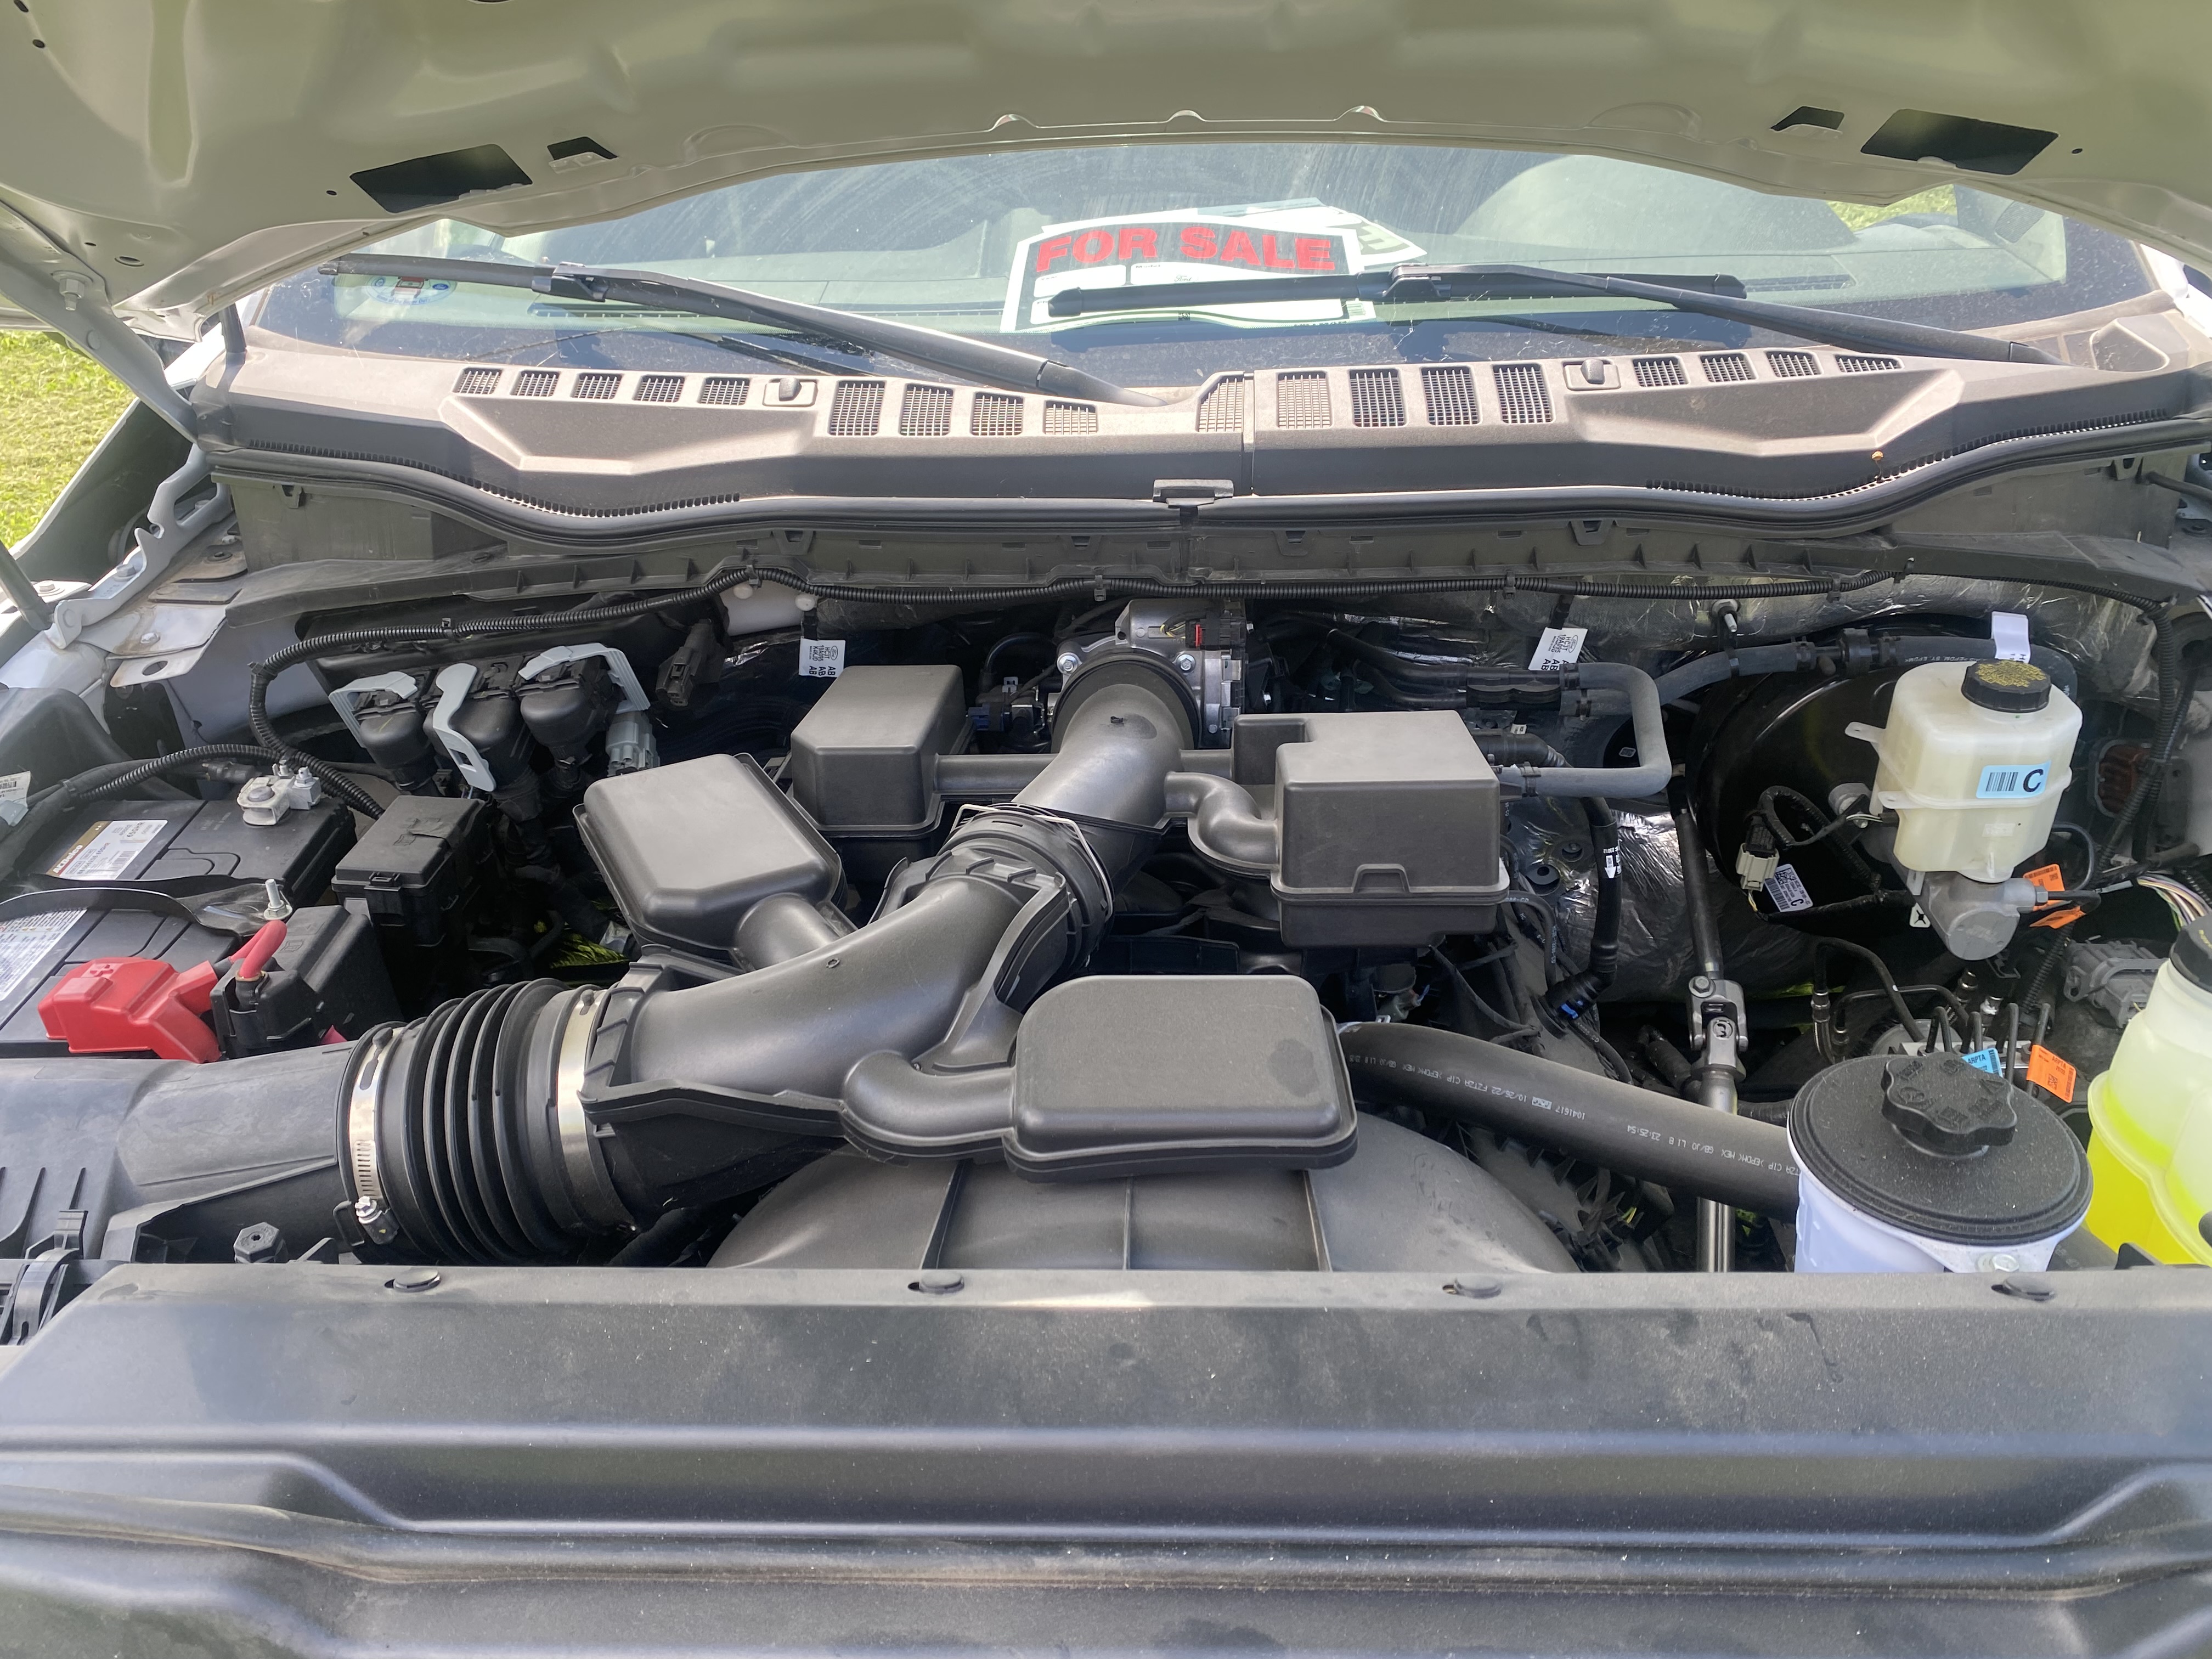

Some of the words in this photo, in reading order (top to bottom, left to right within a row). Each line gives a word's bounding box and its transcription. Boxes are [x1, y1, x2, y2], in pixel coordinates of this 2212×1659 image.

[1036, 228, 1158, 273] FOR
[1180, 226, 1335, 270] SALE
[1555, 634, 1566, 653] 19A095
[1562, 636, 1572, 651] HC3T
[809, 665, 817, 675] AB
[818, 667, 826, 676] AB
[828, 666, 836, 675] AB
[1541, 659, 1551, 670] AB
[1549, 659, 1560, 670] AB
[2023, 769, 2044, 793] C
[52, 845, 83, 874] ACDelco
[1968, 1054, 1986, 1064] ARPTA
[2051, 1055, 2067, 1069] ARPTA
[1555, 1105, 1585, 1120] 1041617
[1627, 1125, 1661, 1141] 23:25:54
[1721, 1149, 1736, 1159] MEX
